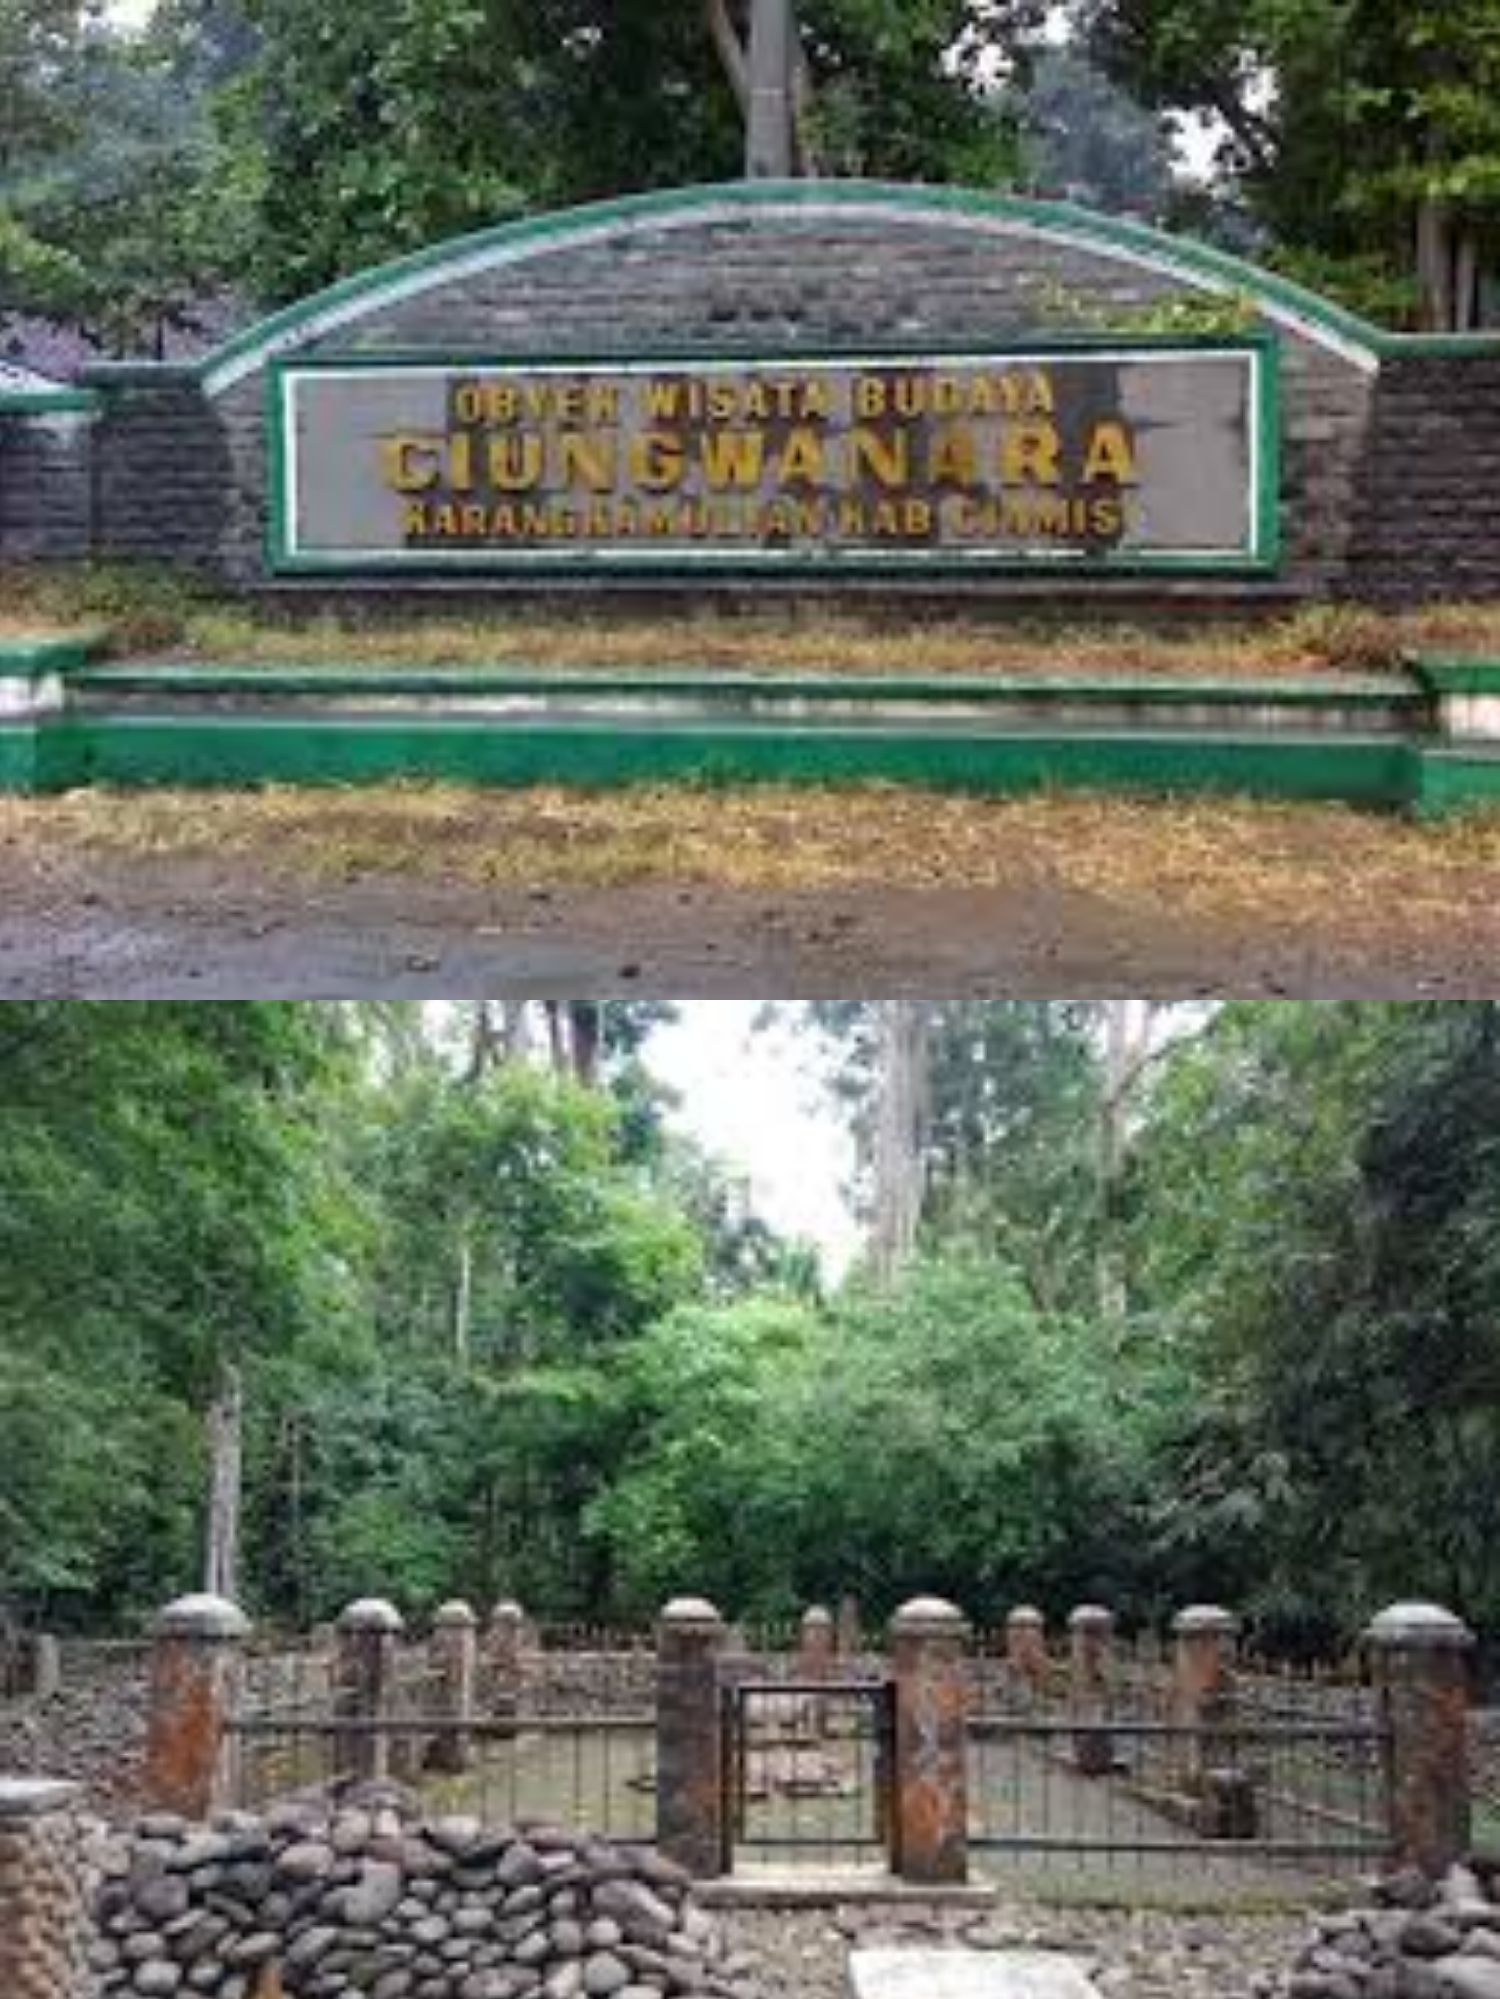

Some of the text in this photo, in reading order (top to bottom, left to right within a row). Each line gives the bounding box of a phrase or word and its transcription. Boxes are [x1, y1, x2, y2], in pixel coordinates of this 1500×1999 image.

[640, 379, 830, 418] WISATA
[856, 372, 1054, 416] BUDAYA
[380, 422, 1137, 493] CIUNGWANARA
